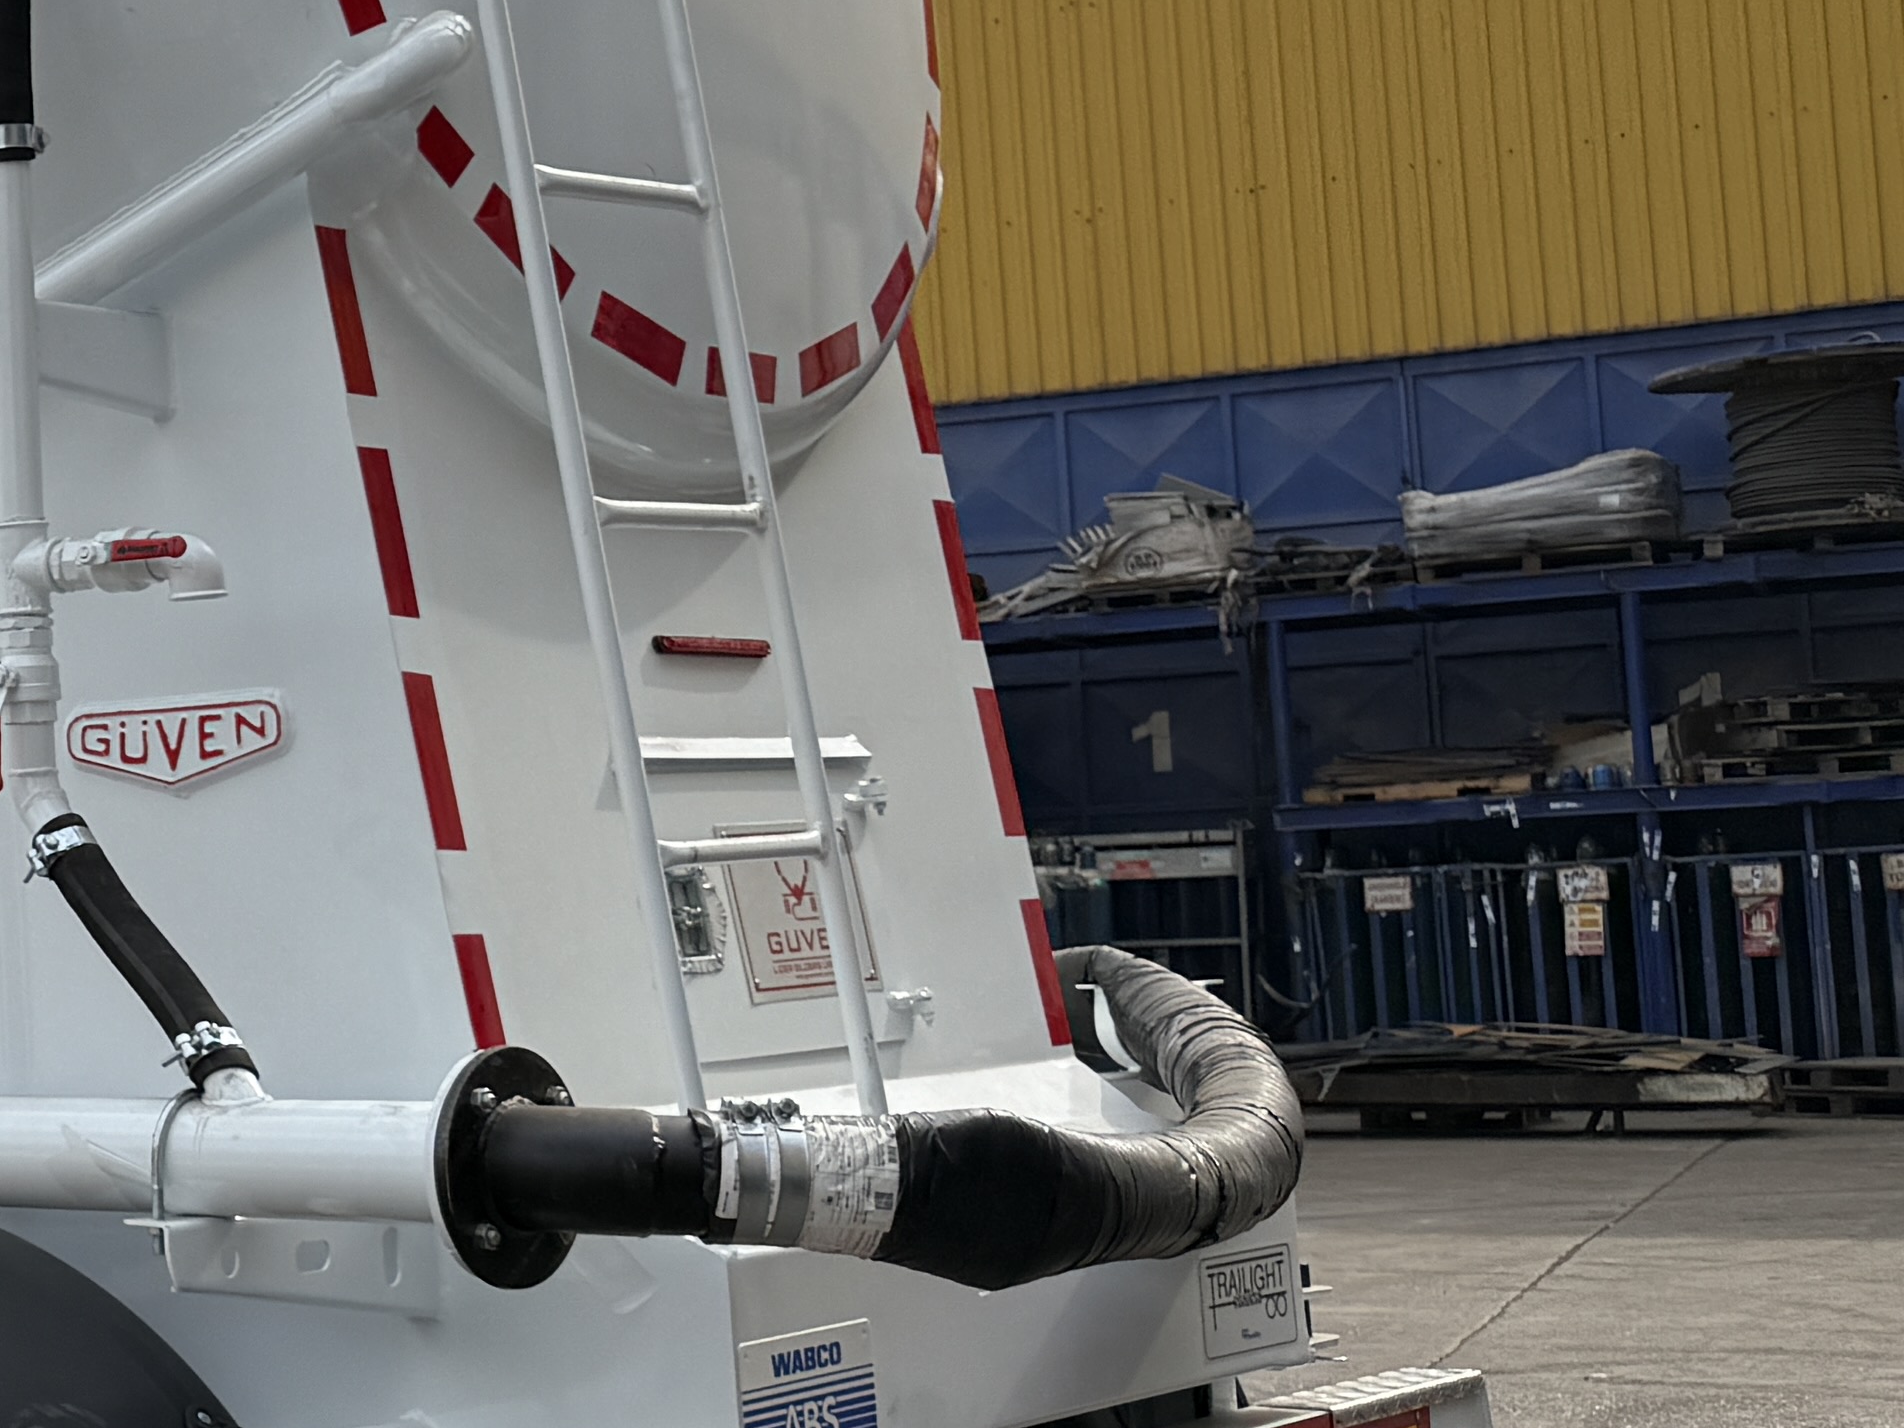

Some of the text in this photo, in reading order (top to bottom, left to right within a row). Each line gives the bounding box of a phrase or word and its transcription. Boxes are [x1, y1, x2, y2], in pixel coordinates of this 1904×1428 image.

[80, 709, 268, 772] GÜVEN
[1131, 710, 1173, 772] 1
[1207, 1260, 1284, 1300] TRAILIGHT
[771, 1341, 842, 1378] WABCO
